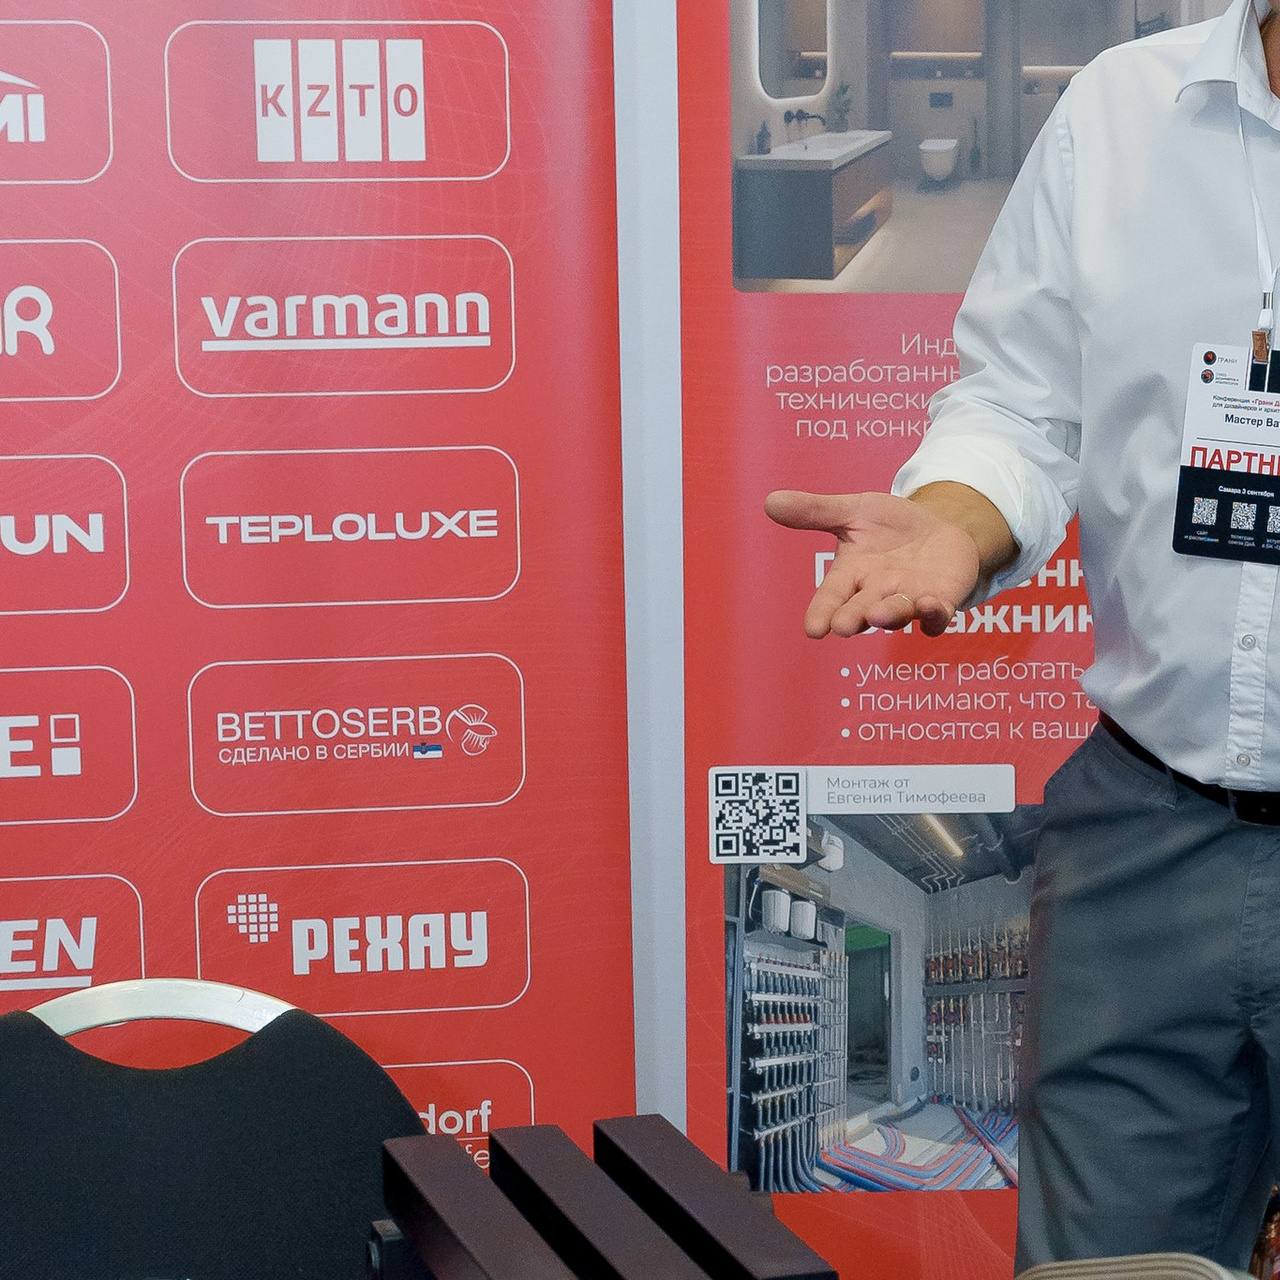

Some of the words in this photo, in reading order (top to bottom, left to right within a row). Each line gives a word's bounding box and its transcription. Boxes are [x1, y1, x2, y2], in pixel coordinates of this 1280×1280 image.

[260, 84, 419, 118] KZTO
[201, 292, 490, 339] varmann
[1212, 395, 1250, 404] Конференция
[1224, 403, 1258, 412] дизайнеров
[796, 420, 849, 440] под
[1224, 413, 1263, 427] Мастер
[206, 510, 498, 544] TEPLOLUXE
[856, 663, 949, 688] умеют
[957, 656, 1085, 685] работать
[859, 693, 1013, 713] понимают,
[1019, 692, 1066, 709] что
[217, 705, 442, 742] BETTOSERB
[858, 722, 1000, 741] относятся
[1009, 723, 1024, 739] к
[219, 745, 310, 765] СДЕЛАНО
[316, 745, 328, 760] В
[333, 742, 409, 759] СЕРБИИ
[827, 777, 888, 789] Монтаж
[893, 778, 910, 789] от
[827, 792, 892, 804] Евгения
[899, 791, 986, 806] Тимофеева
[292, 911, 488, 975] РЕХАУ
